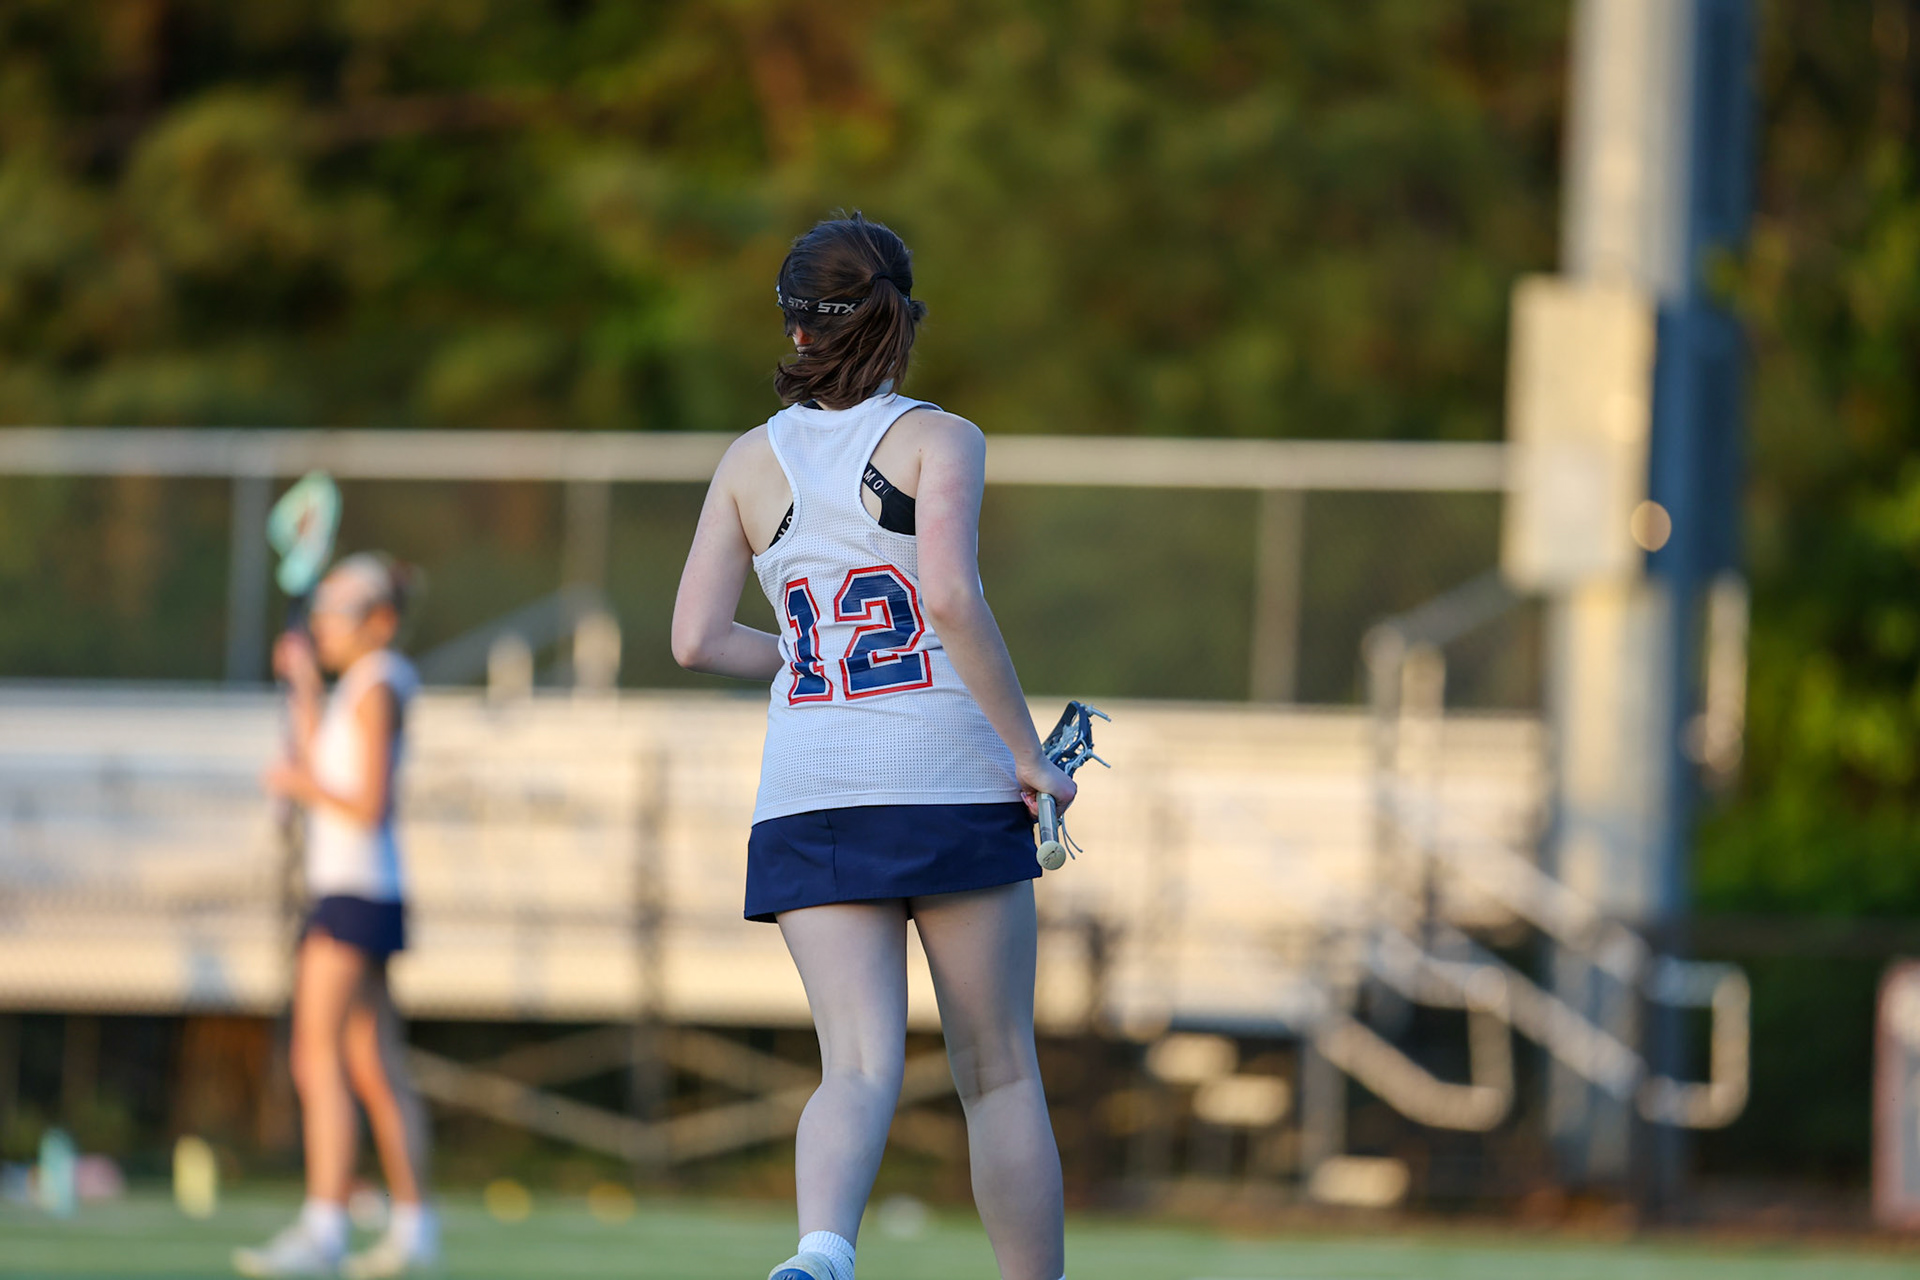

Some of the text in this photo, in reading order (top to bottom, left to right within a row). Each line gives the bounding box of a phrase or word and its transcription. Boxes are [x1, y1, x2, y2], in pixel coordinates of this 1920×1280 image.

[788, 297, 809, 311] STX
[817, 302, 856, 314] STX
[863, 469, 890, 496] MO
[785, 564, 933, 705] 12
